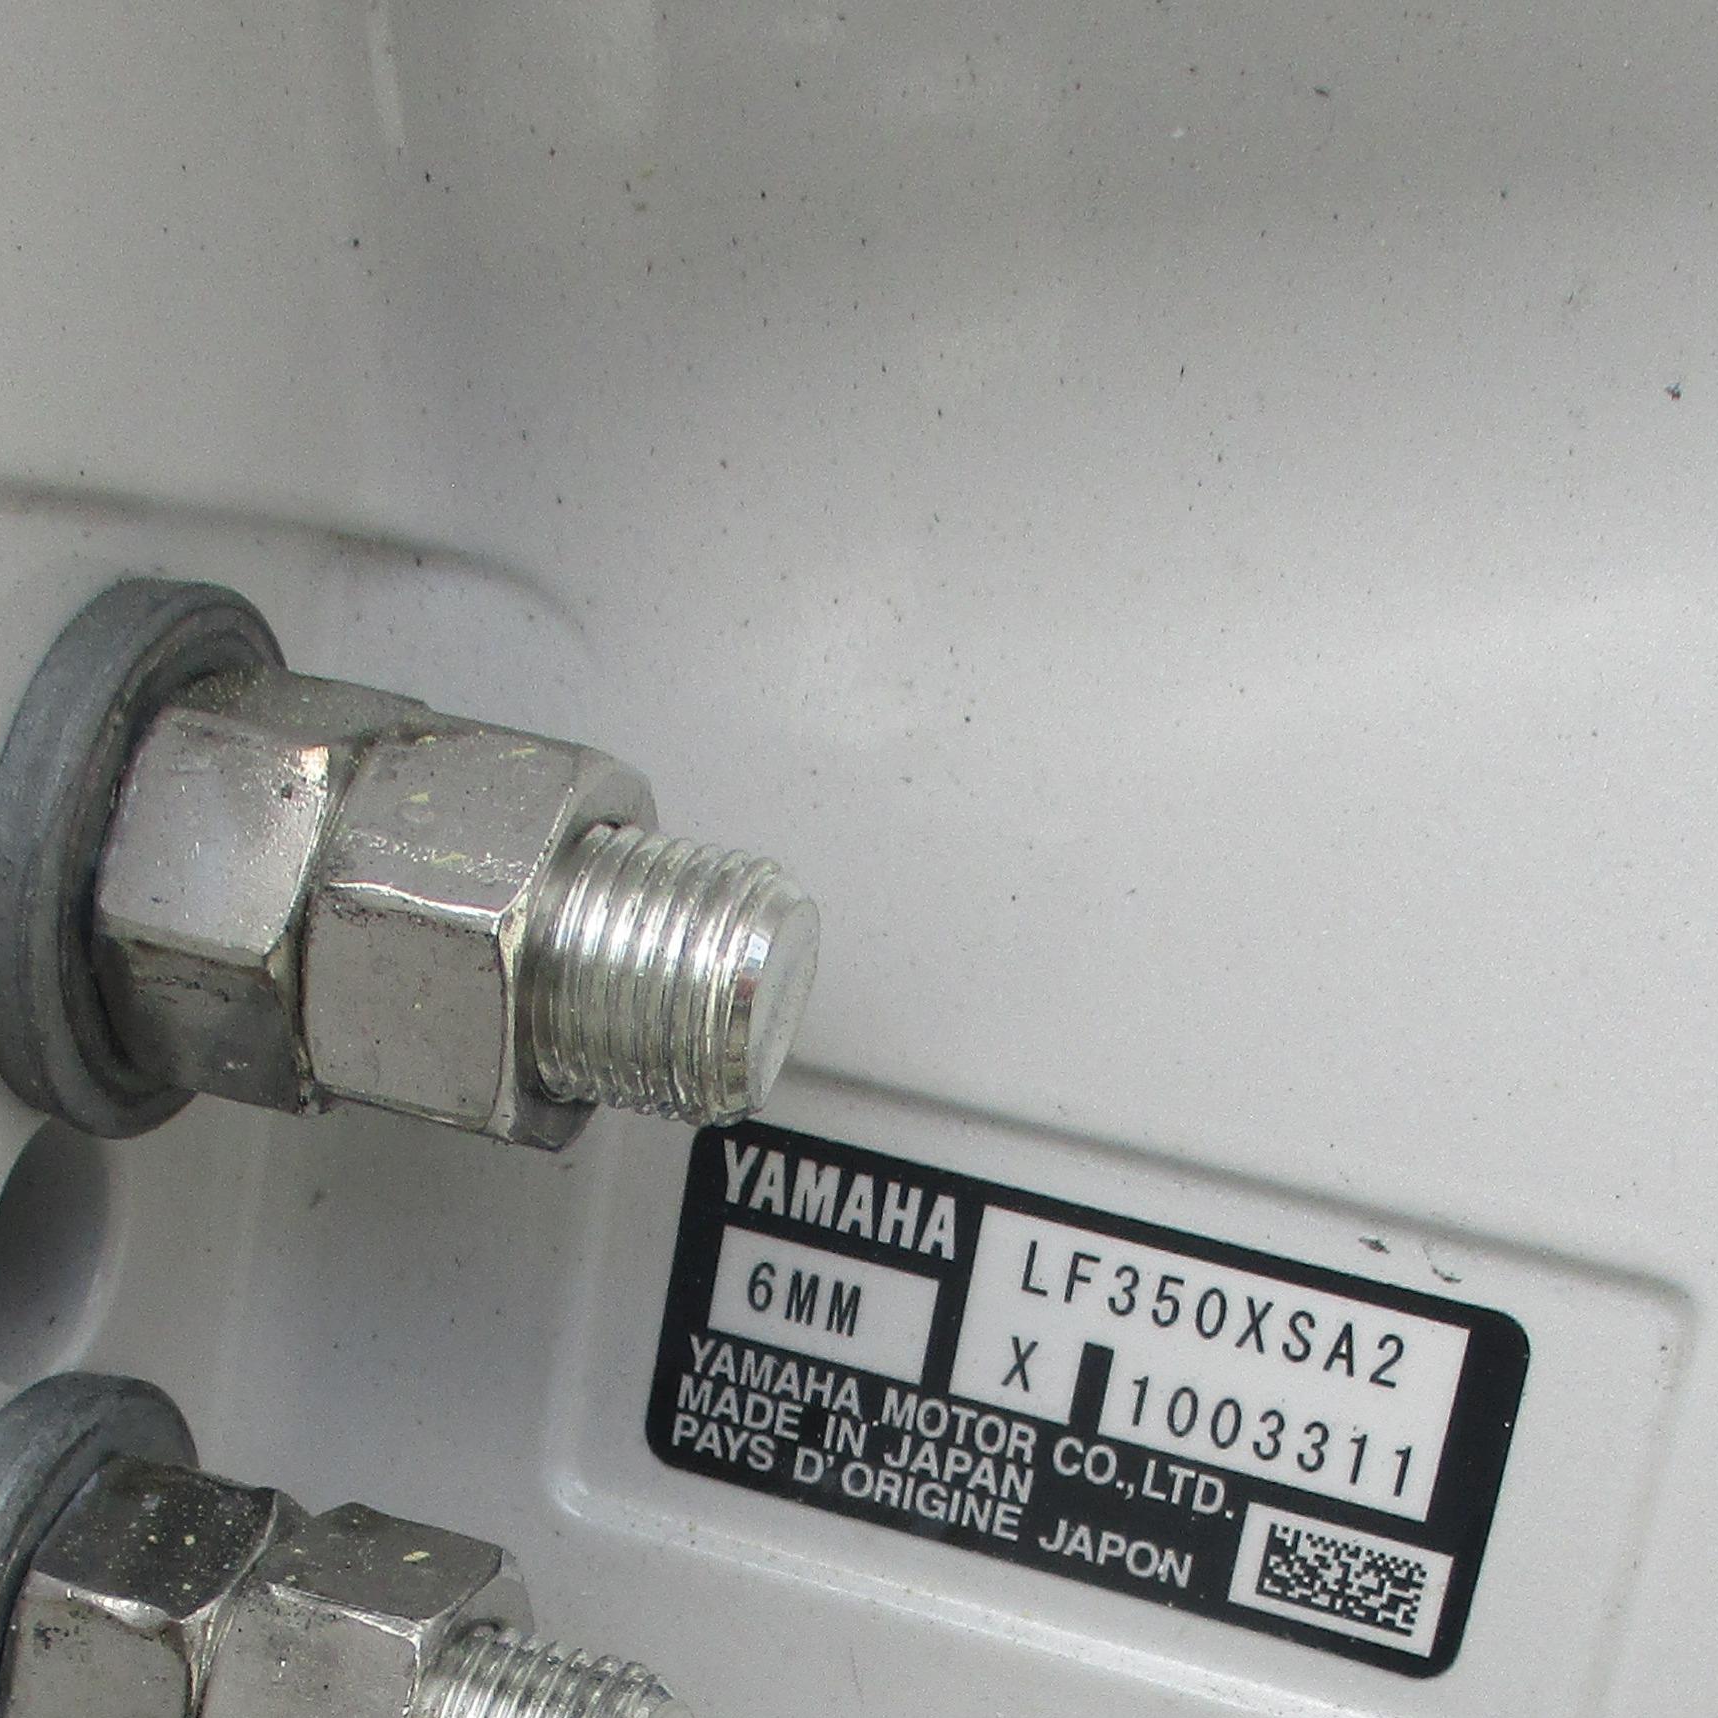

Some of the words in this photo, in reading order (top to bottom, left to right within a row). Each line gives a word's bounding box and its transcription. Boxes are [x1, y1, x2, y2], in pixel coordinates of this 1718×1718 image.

[722, 1138, 957, 1262] YAMAHA
[746, 1262, 862, 1337] 6MM
[1021, 1239, 1404, 1389] LF350XSA2
[688, 1333, 862, 1420] YAMAHA
[883, 1388, 1037, 1465] MOTOR
[1001, 1335, 1039, 1393] X
[677, 1374, 802, 1441] MADE
[823, 1414, 868, 1459] IN
[883, 1434, 1035, 1505] JAPAN
[1130, 1374, 1414, 1498] 1003311
[672, 1413, 776, 1473] PAYS
[1038, 1519, 1194, 1590] JAPON
